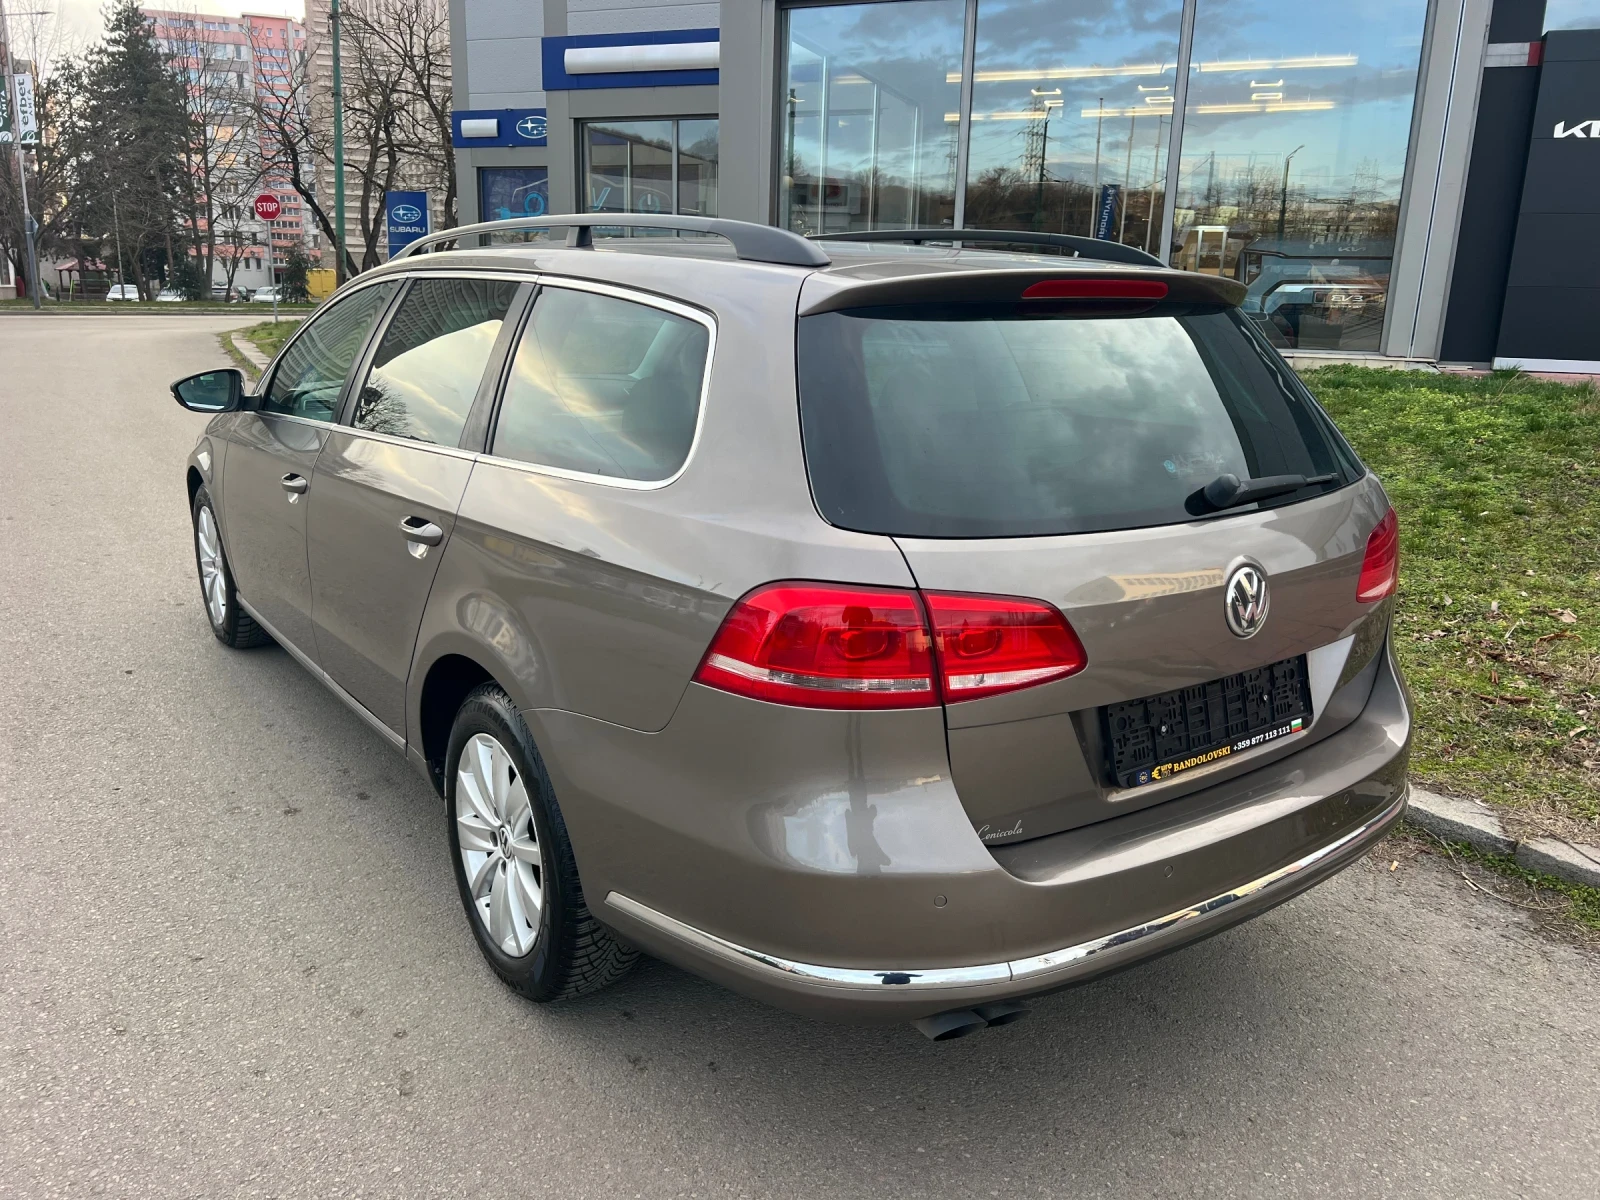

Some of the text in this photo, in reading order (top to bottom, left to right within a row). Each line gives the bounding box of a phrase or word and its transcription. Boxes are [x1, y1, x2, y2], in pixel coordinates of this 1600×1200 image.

[17, 78, 29, 125] efbet
[1553, 120, 1600, 138] KI
[257, 202, 278, 212] STOP
[1098, 196, 1113, 238] HYUNDAI
[1173, 745, 1231, 772] BANDOLOVSKI
[1233, 739, 1251, 752] +359
[1251, 734, 1264, 745] 877
[1264, 729, 1277, 740] 113
[1279, 725, 1290, 735] 111
